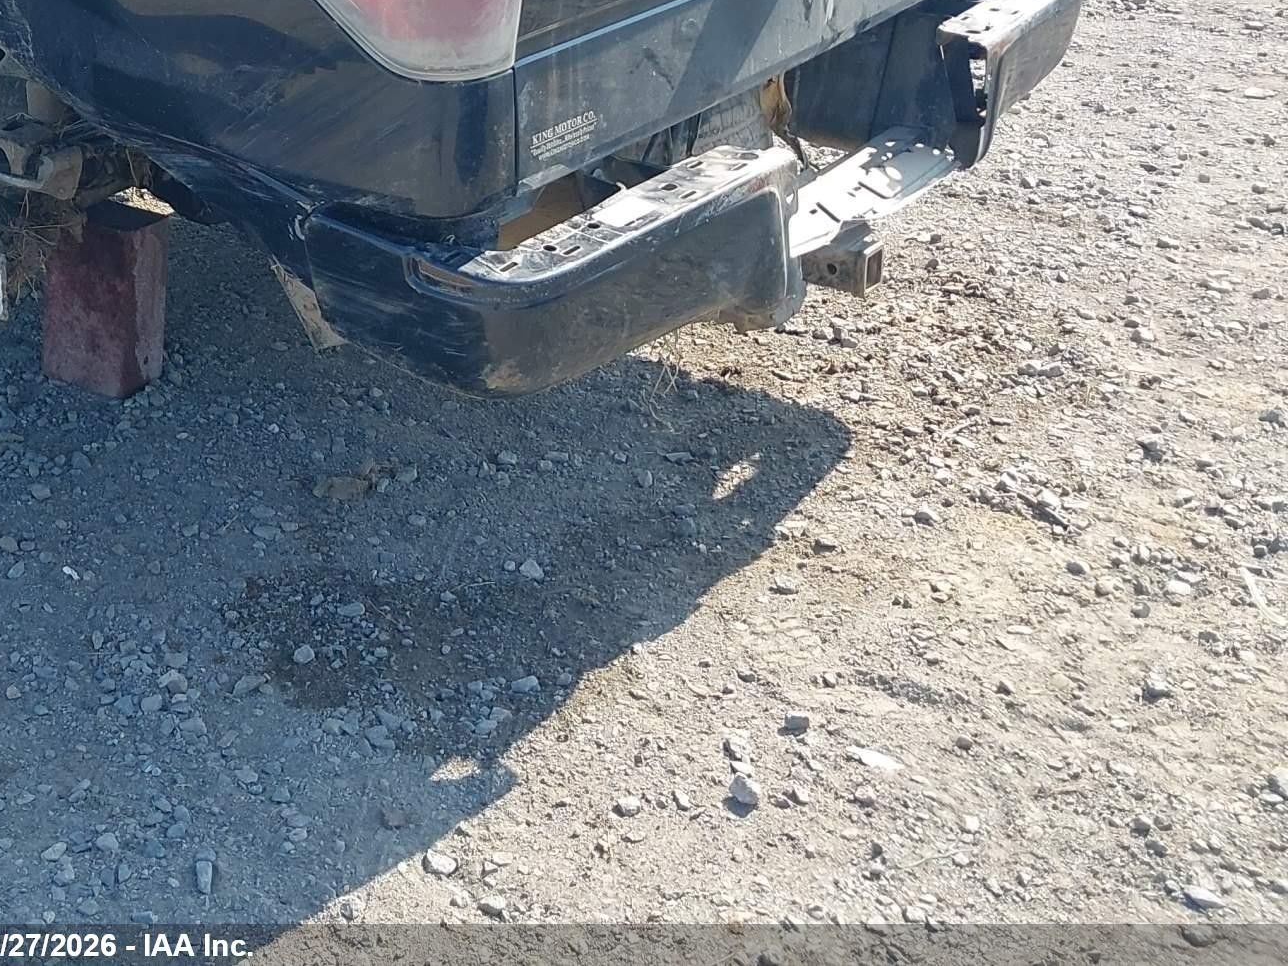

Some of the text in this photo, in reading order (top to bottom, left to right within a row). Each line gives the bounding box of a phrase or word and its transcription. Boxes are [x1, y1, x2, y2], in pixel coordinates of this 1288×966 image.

[531, 126, 554, 146] KING
[554, 115, 583, 136] MOTOR
[582, 110, 596, 123] CO.
